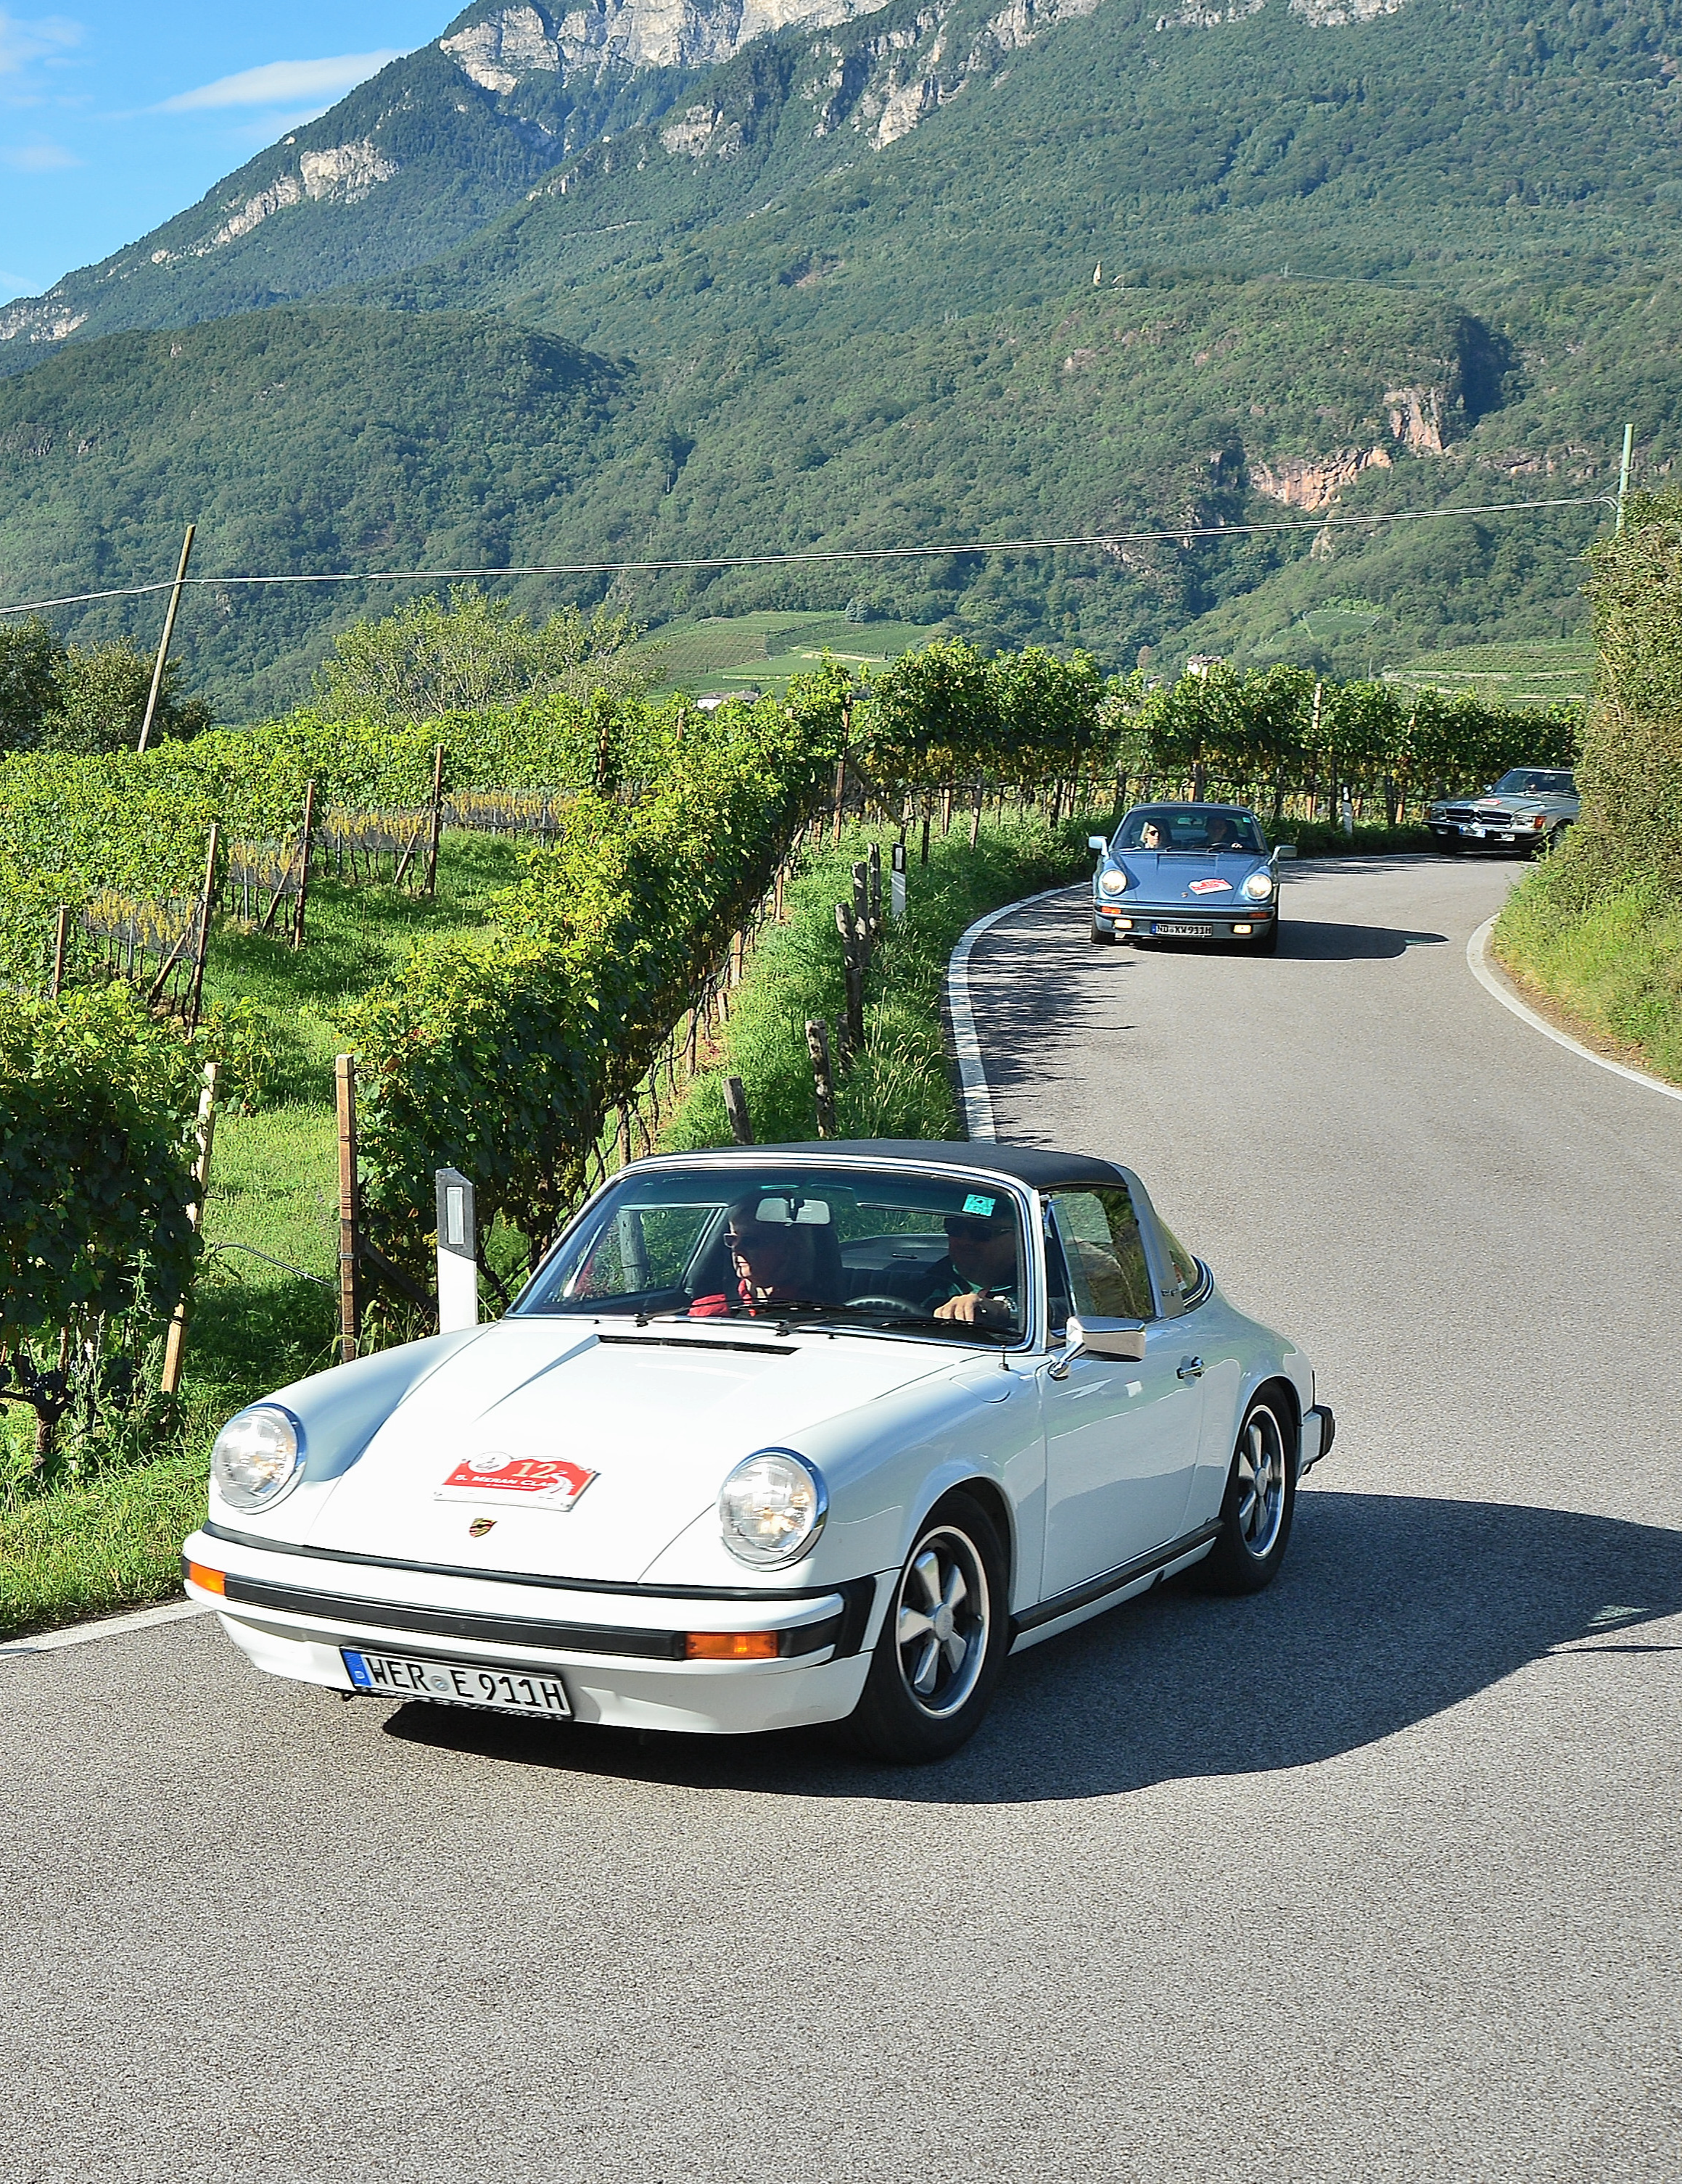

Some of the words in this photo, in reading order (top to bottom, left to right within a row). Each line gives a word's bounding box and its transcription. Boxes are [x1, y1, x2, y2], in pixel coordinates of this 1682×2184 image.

[512, 1462, 557, 1479] 12
[450, 1669, 474, 1698] E
[479, 1674, 565, 1711] 911H
